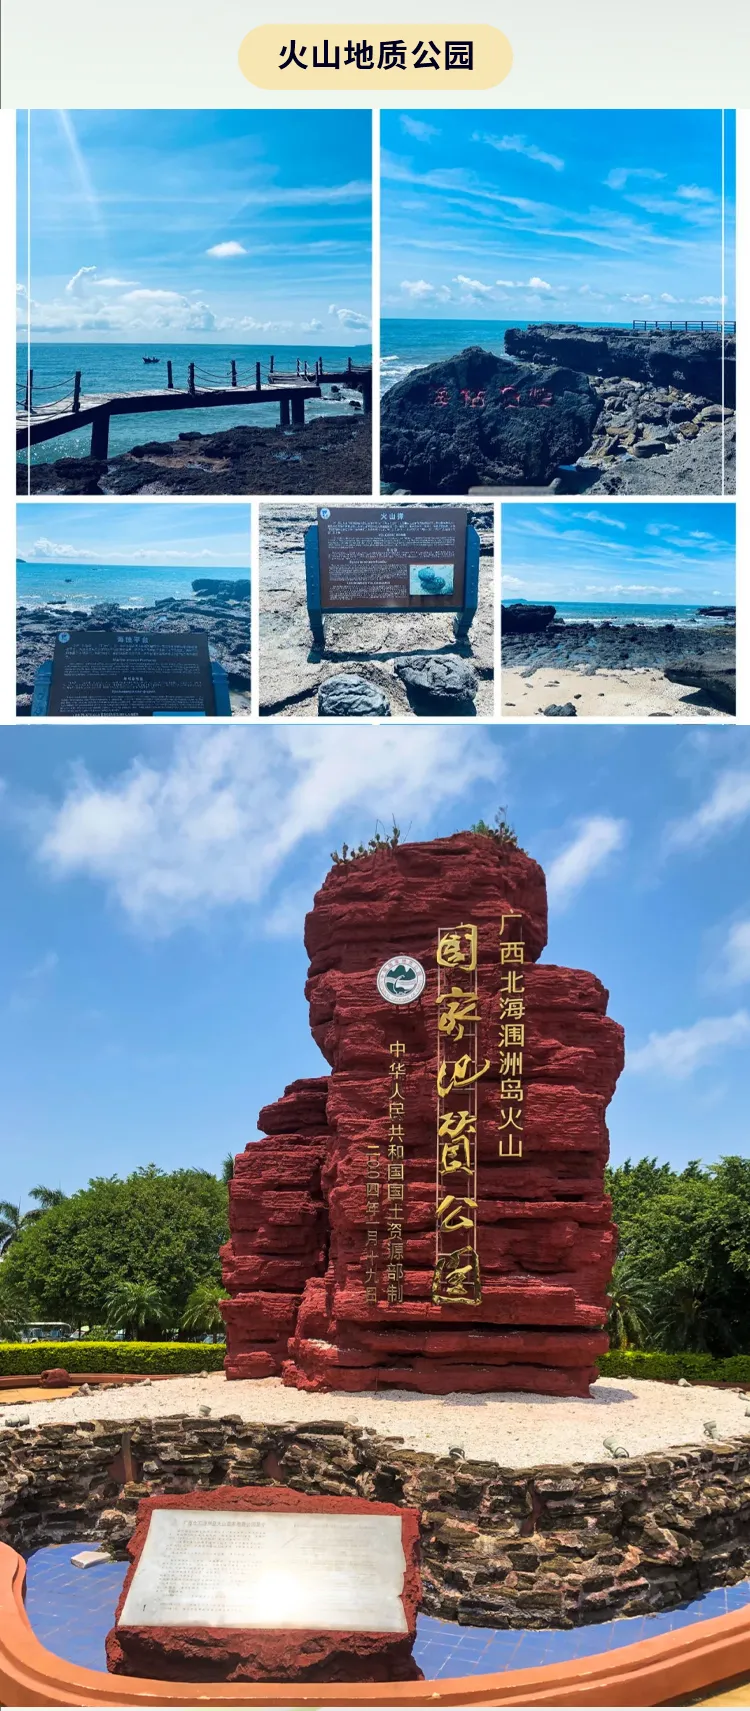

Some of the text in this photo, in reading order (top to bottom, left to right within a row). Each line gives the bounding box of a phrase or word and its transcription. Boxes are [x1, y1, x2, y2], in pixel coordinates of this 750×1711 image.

[498, 909, 525, 1158] 广西北海涠洲岛火山
[386, 1040, 406, 1303] 中华人民共和国国土资源部制
